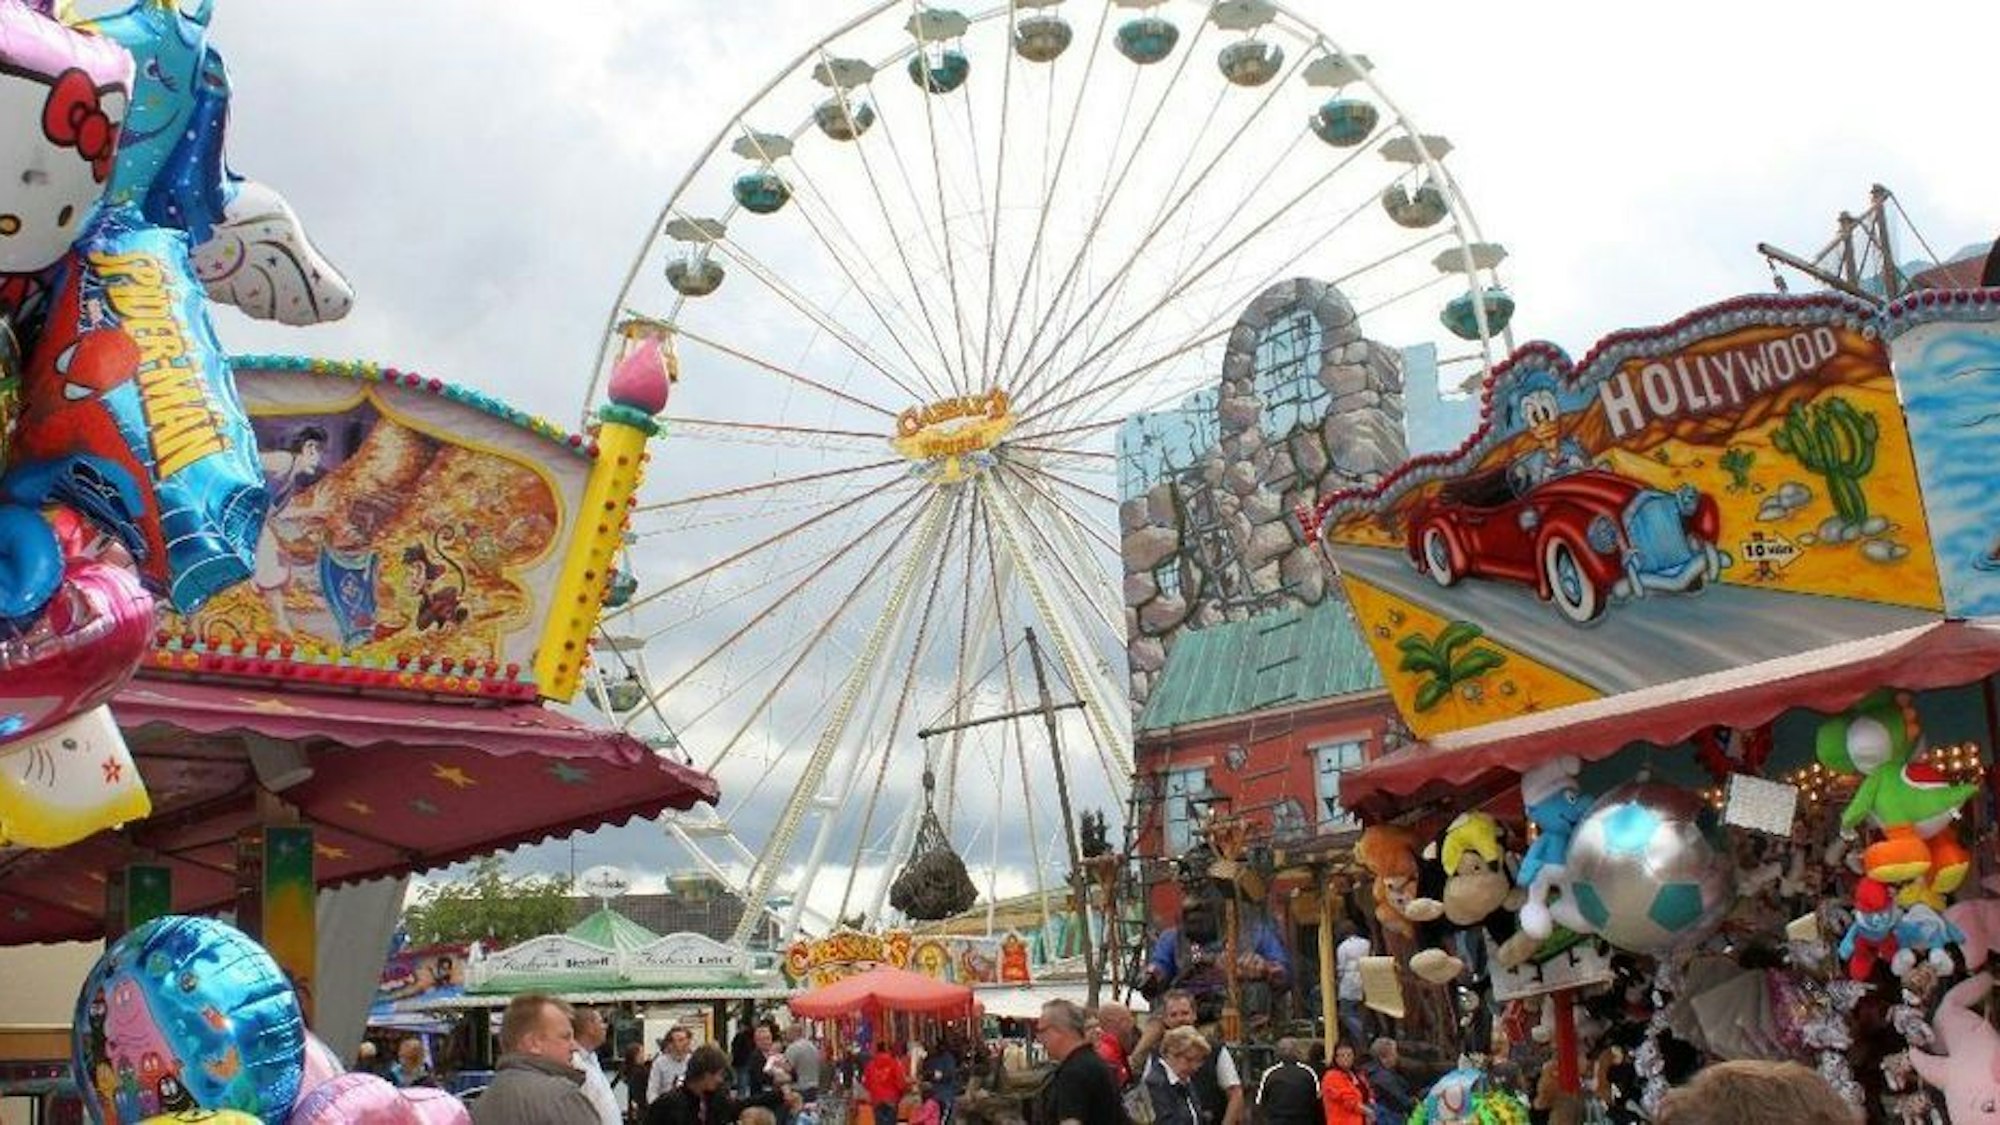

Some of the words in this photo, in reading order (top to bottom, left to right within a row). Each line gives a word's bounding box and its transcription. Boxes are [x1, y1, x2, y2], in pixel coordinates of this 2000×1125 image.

[88, 251, 227, 479] SPIDER-MAN
[1599, 326, 1838, 438] HOLLYWOOD
[1746, 544, 1765, 557] 10
